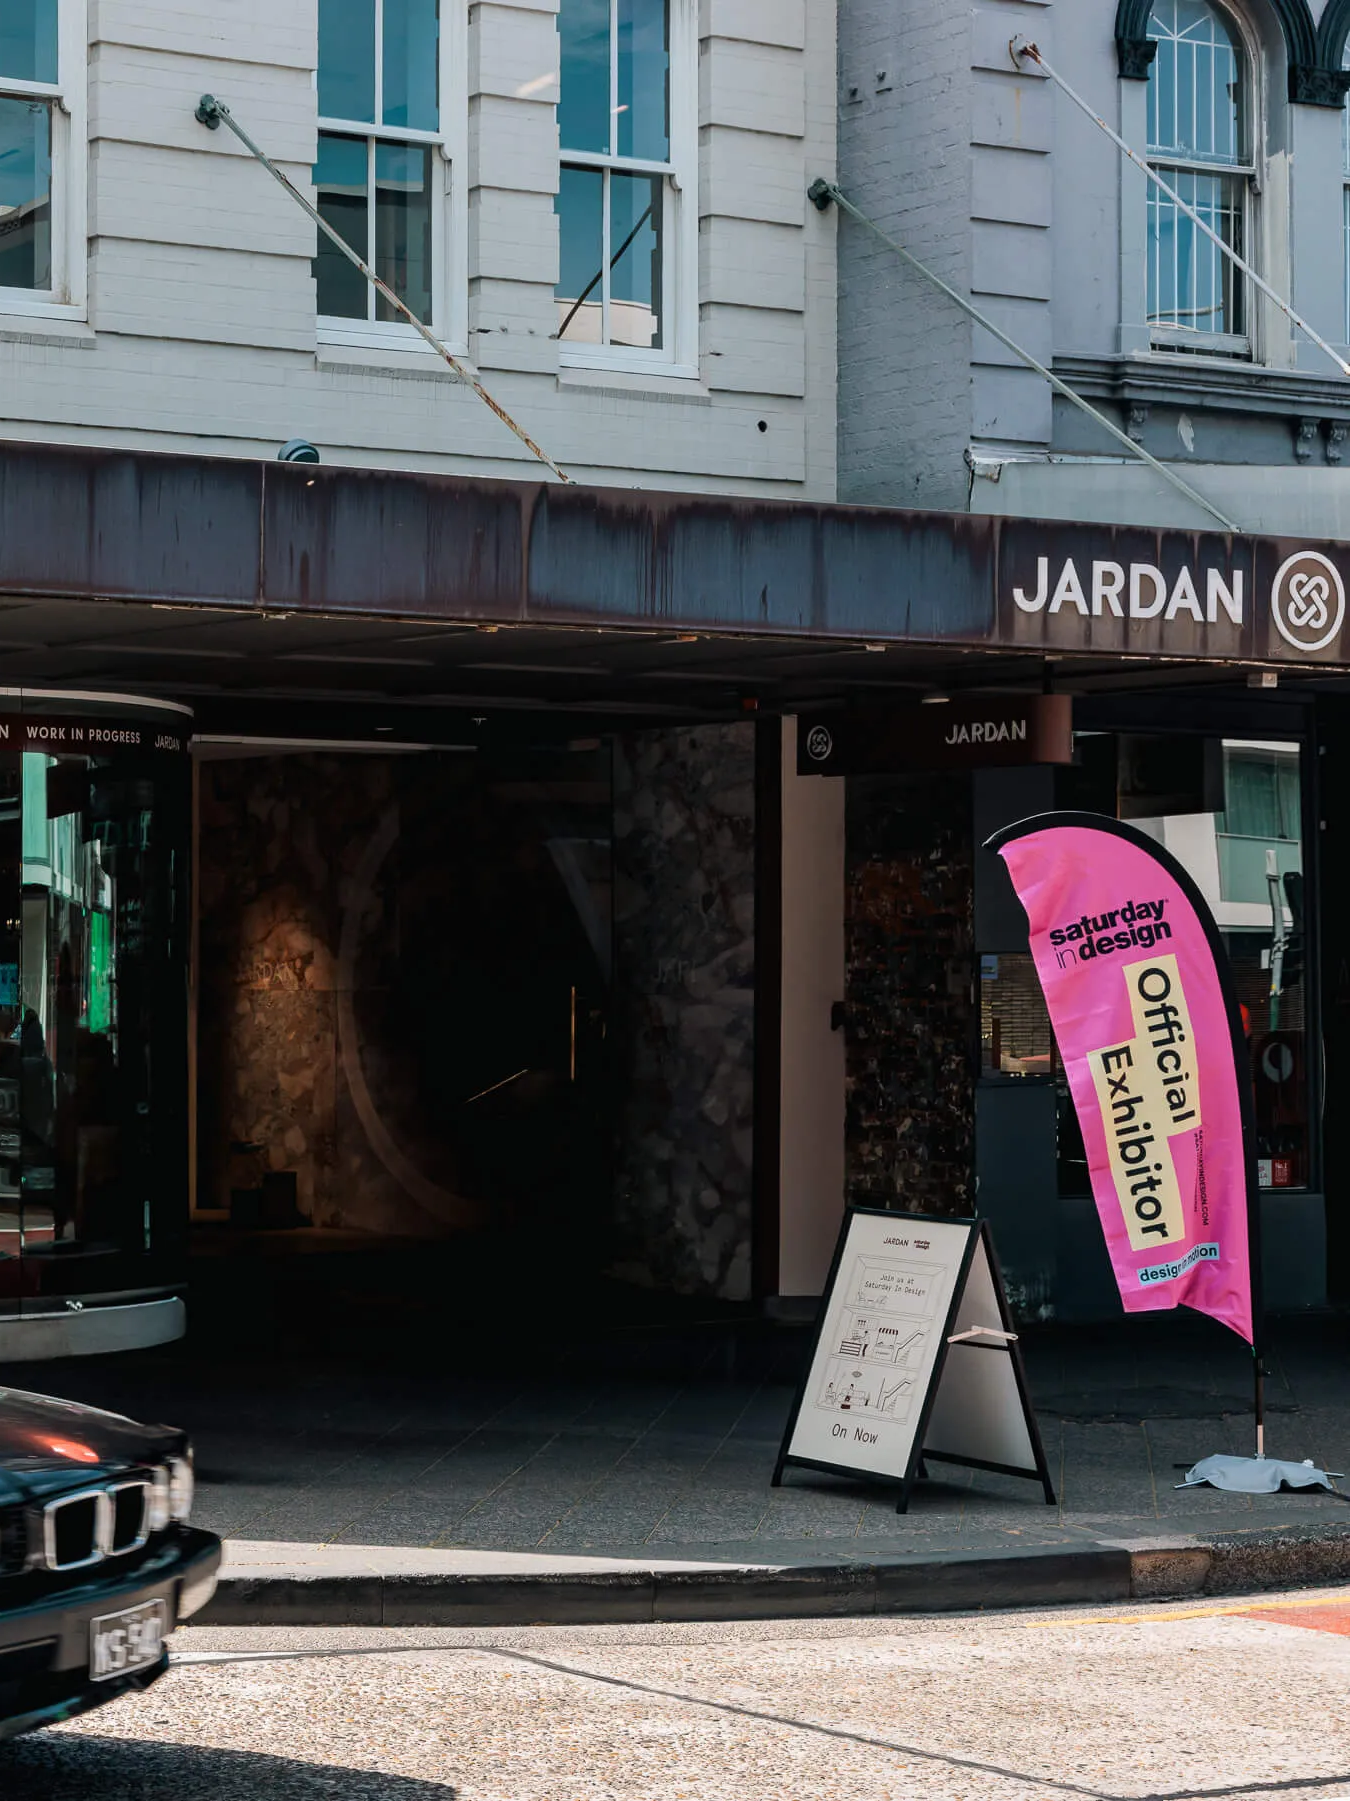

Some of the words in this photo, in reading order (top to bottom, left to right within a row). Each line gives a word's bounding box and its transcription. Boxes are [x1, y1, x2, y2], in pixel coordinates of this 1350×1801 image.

[1012, 556, 1243, 624] JARDAN
[26, 726, 66, 740] WORK
[71, 727, 84, 740] IN
[88, 728, 141, 744] PROGRESS
[154, 735, 180, 751] JARDAN
[945, 719, 1026, 745] JARDAN
[1050, 901, 1164, 946] saturday
[1054, 947, 1077, 969] in
[1078, 921, 1172, 961] design
[1137, 967, 1196, 1124] Official
[1101, 1045, 1169, 1238] Exhibitor
[883, 1237, 910, 1247] JARDAN
[832, 1423, 848, 1439] On
[853, 1426, 879, 1445] Now
